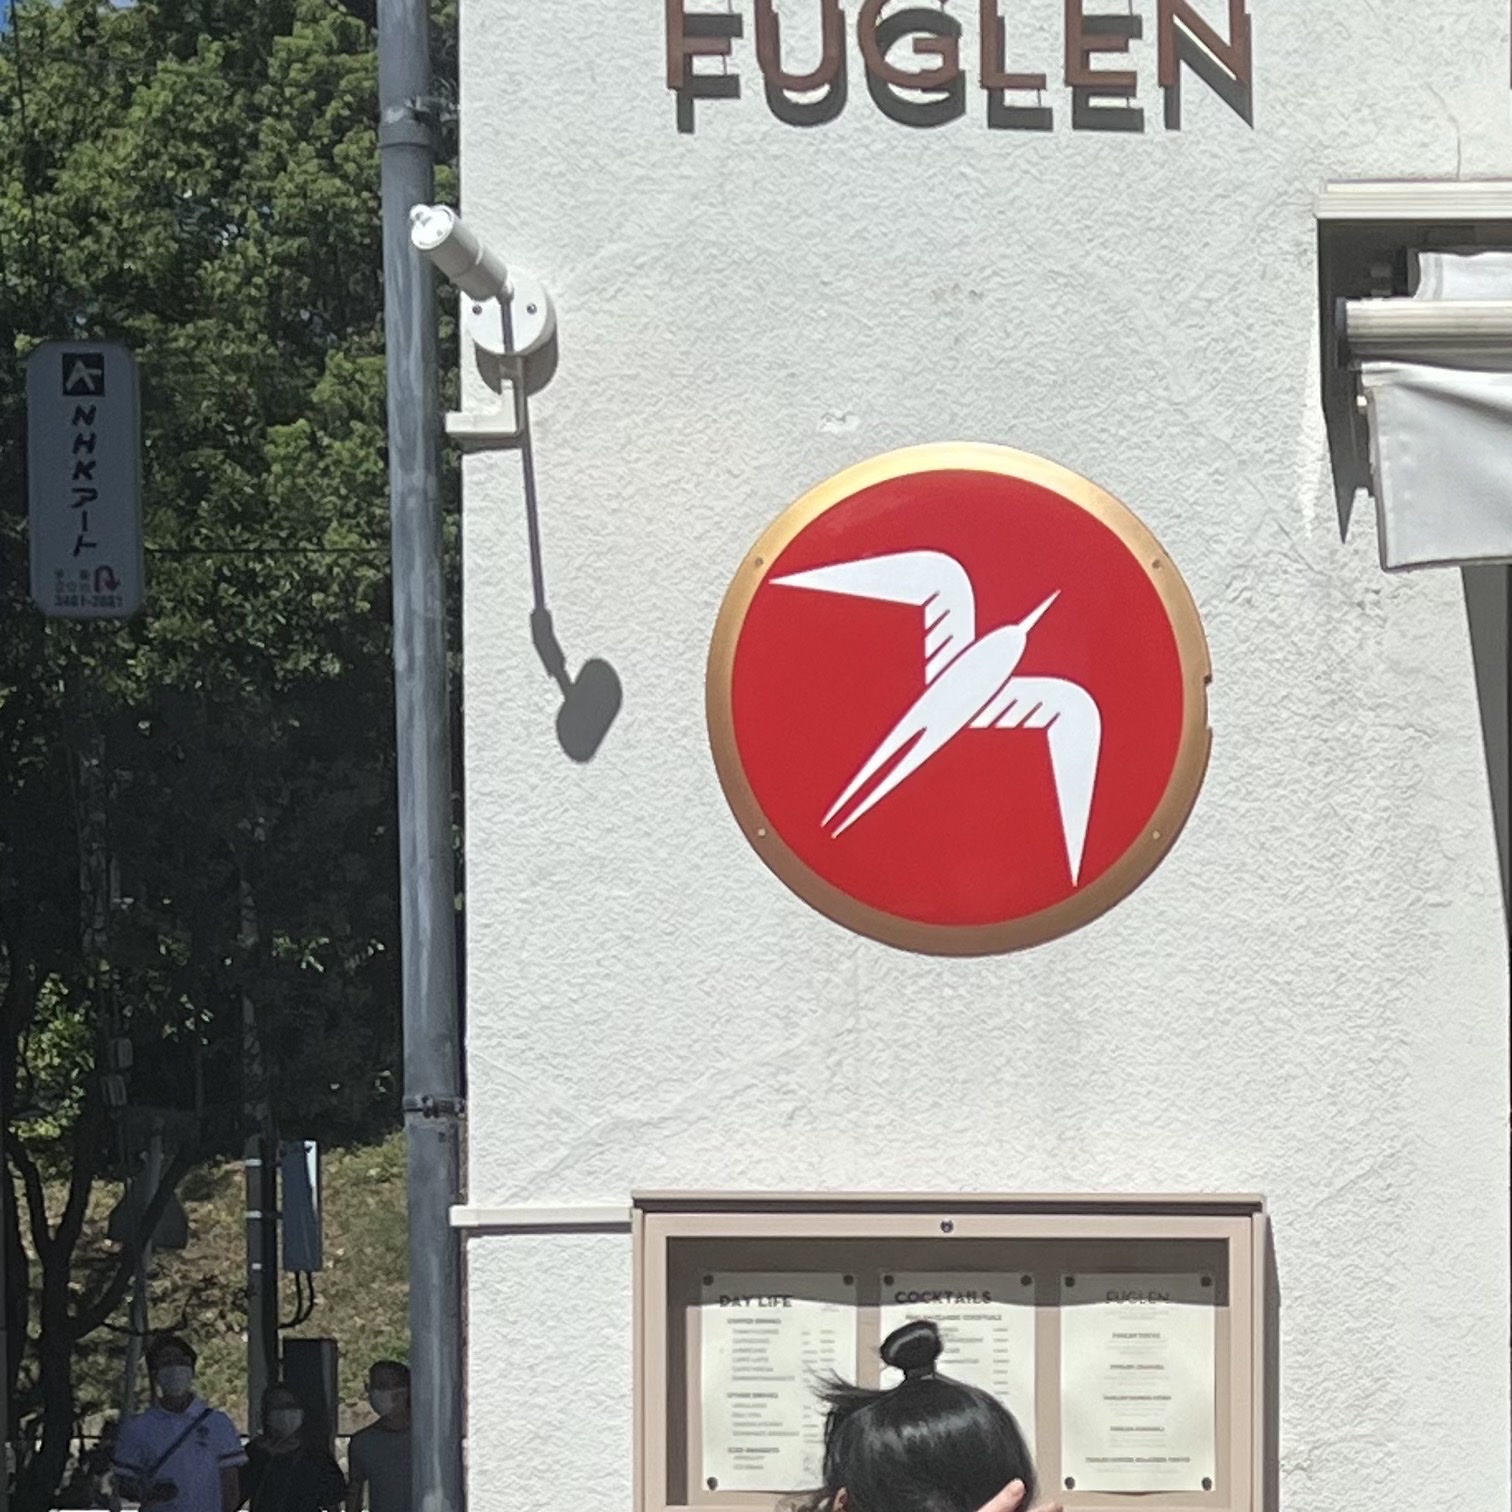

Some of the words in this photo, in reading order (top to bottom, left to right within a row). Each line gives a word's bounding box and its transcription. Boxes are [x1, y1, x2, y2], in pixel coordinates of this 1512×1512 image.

[666, 0, 1250, 90] FUGLEN
[71, 403, 98, 557] NHKアート
[719, 1294, 754, 1308] DAY
[758, 1294, 793, 1308] LIFE
[894, 1290, 992, 1304] COCKTAILS
[1106, 1290, 1171, 1304] FUGLEN
